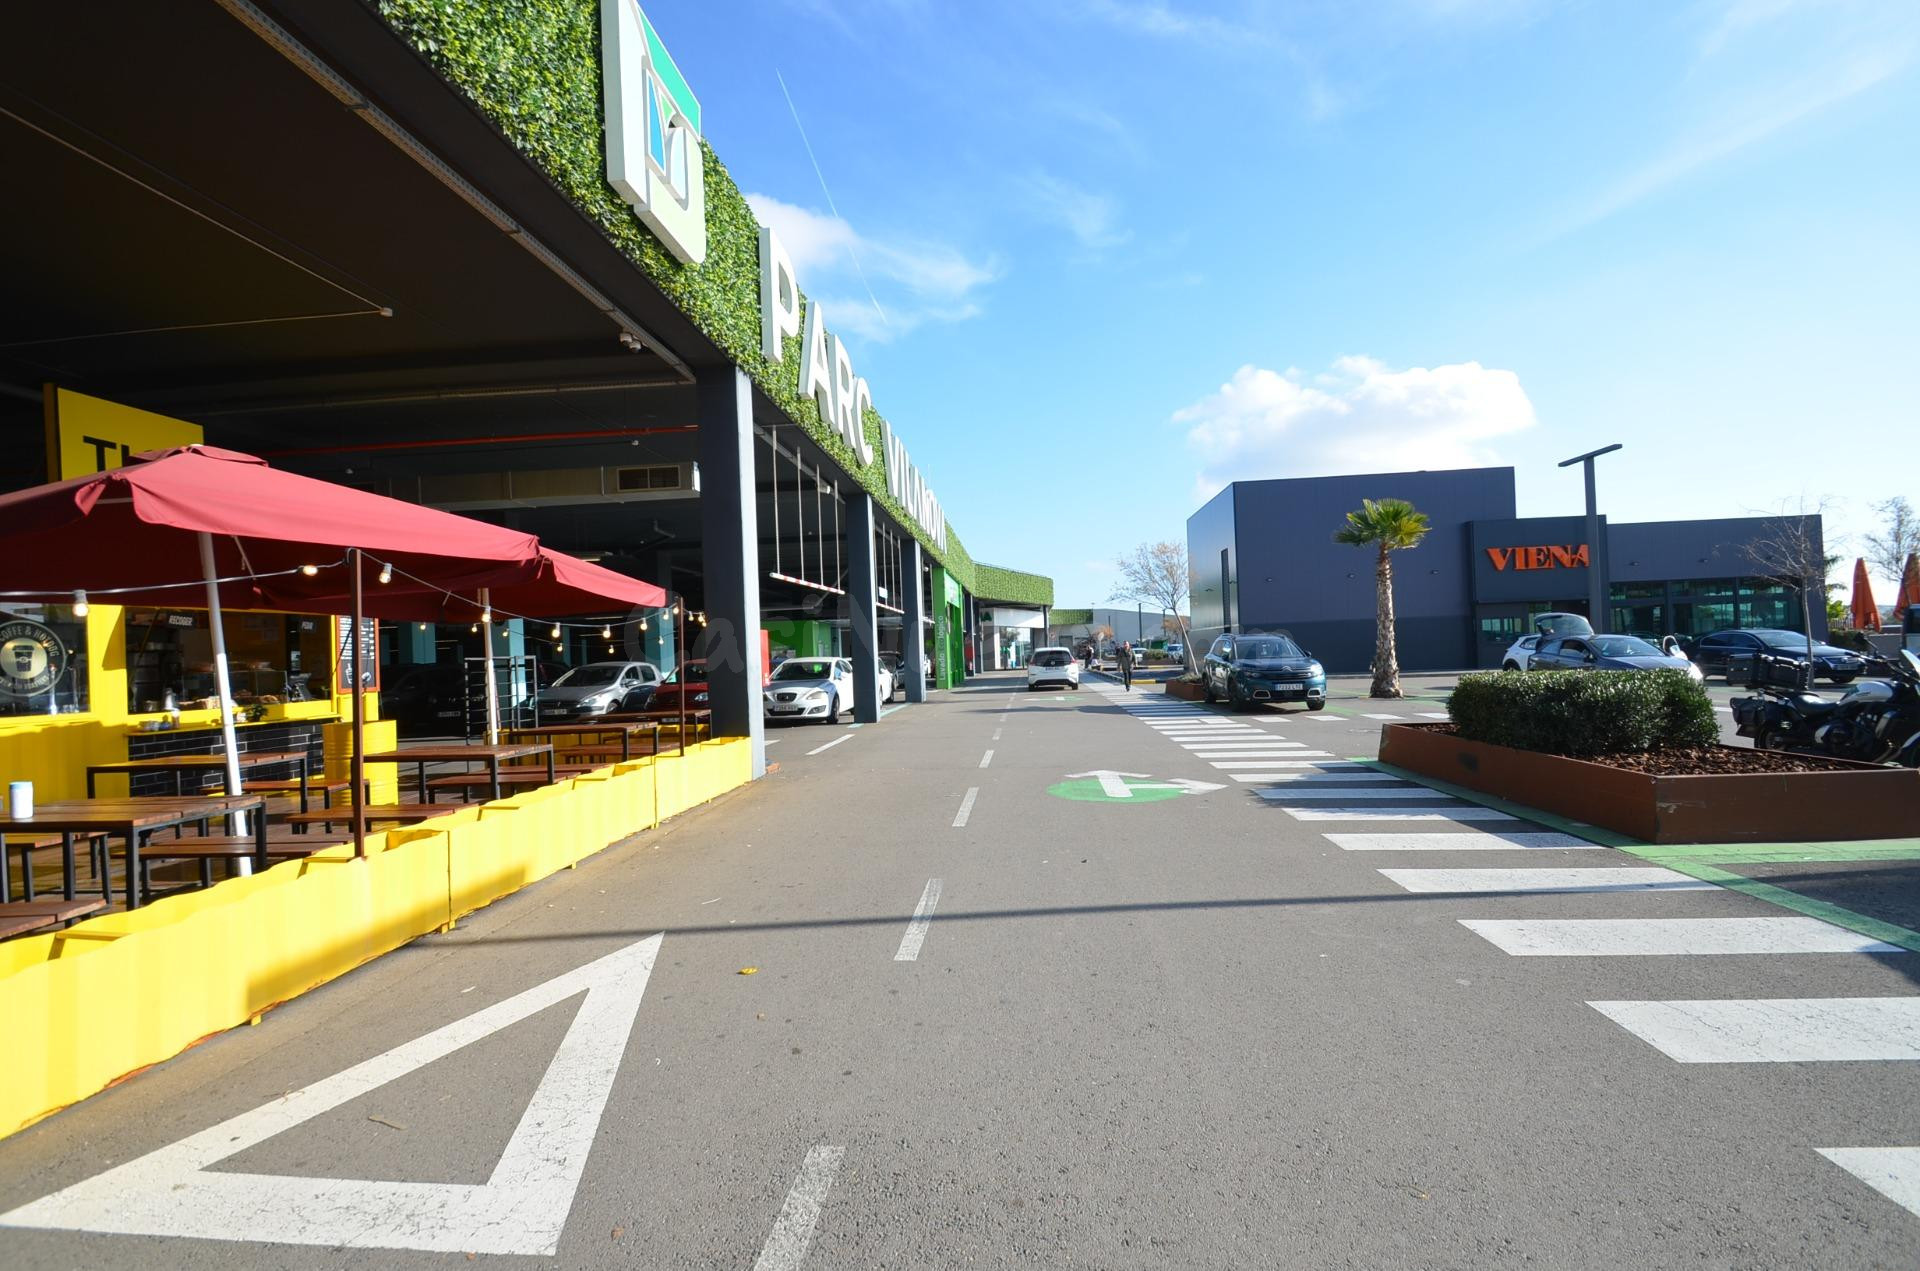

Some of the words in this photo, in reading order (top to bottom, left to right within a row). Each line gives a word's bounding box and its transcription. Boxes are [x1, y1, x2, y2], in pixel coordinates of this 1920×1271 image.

[757, 227, 874, 467] PARC
[881, 419, 947, 555] VILANOVA
[83, 435, 130, 472] T
[1486, 543, 1591, 571] VIENA
[937, 653, 946, 681] Lavado
